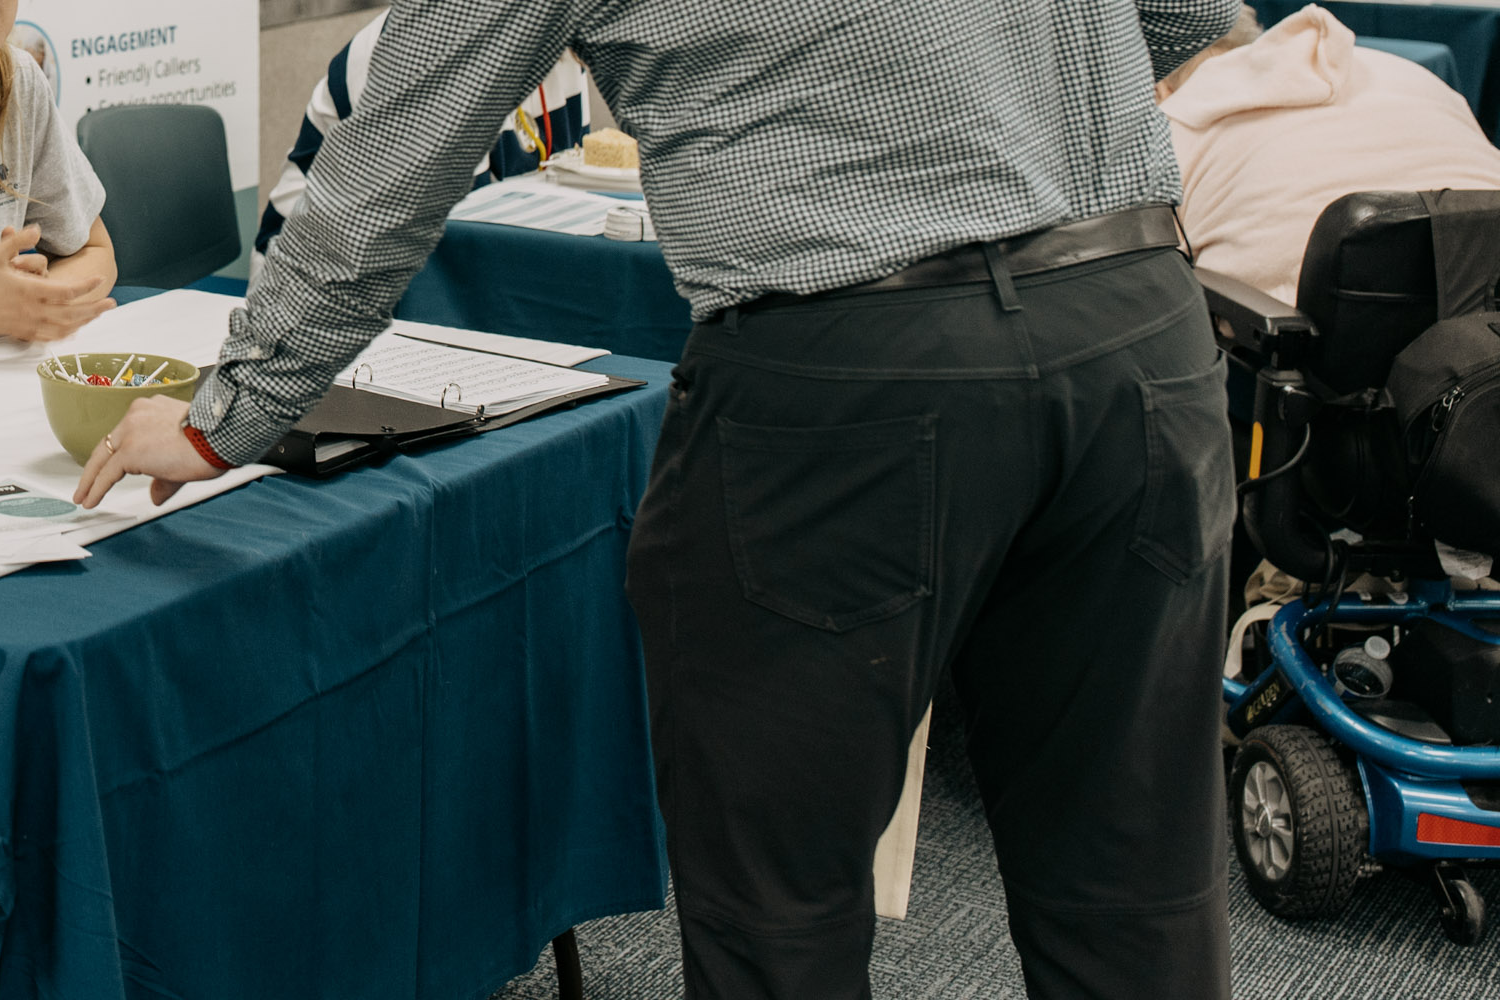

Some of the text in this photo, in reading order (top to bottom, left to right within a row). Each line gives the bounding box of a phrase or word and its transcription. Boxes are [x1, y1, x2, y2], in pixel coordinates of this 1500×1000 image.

[72, 25, 178, 59] ENGAGEMENT
[99, 56, 202, 87] Friendly Callers
